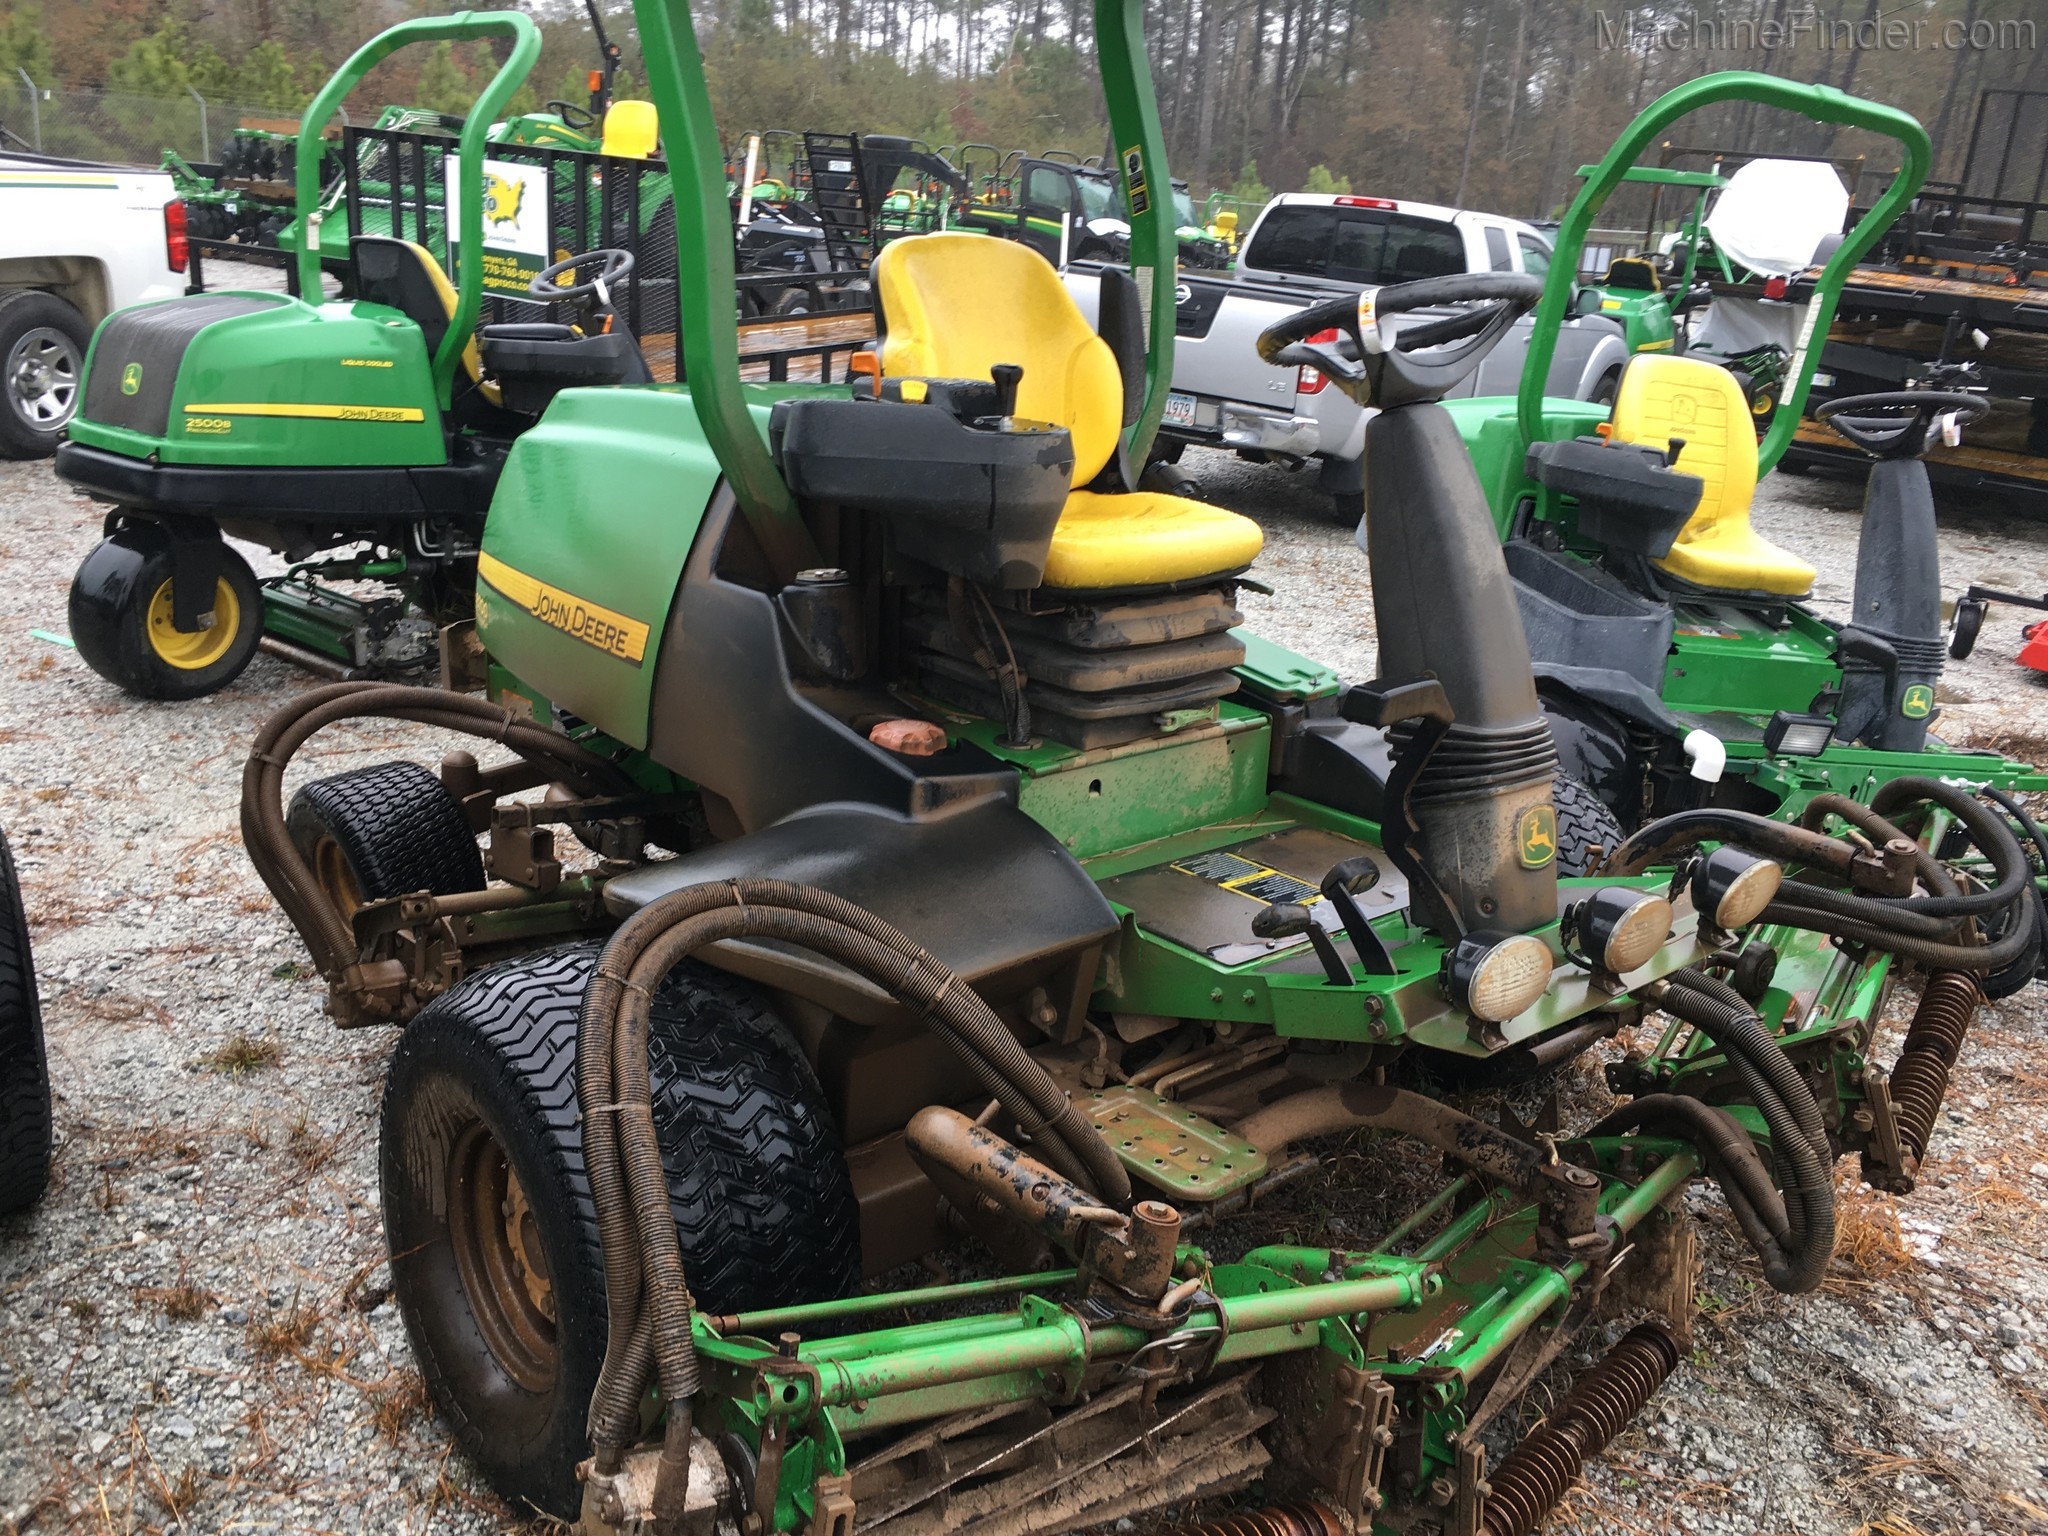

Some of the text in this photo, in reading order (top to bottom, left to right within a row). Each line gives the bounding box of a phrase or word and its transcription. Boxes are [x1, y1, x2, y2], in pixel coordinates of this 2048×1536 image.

[338, 407, 405, 420] JOHN DEERE
[532, 588, 571, 633] JOHN
[573, 605, 629, 654] DEERE
